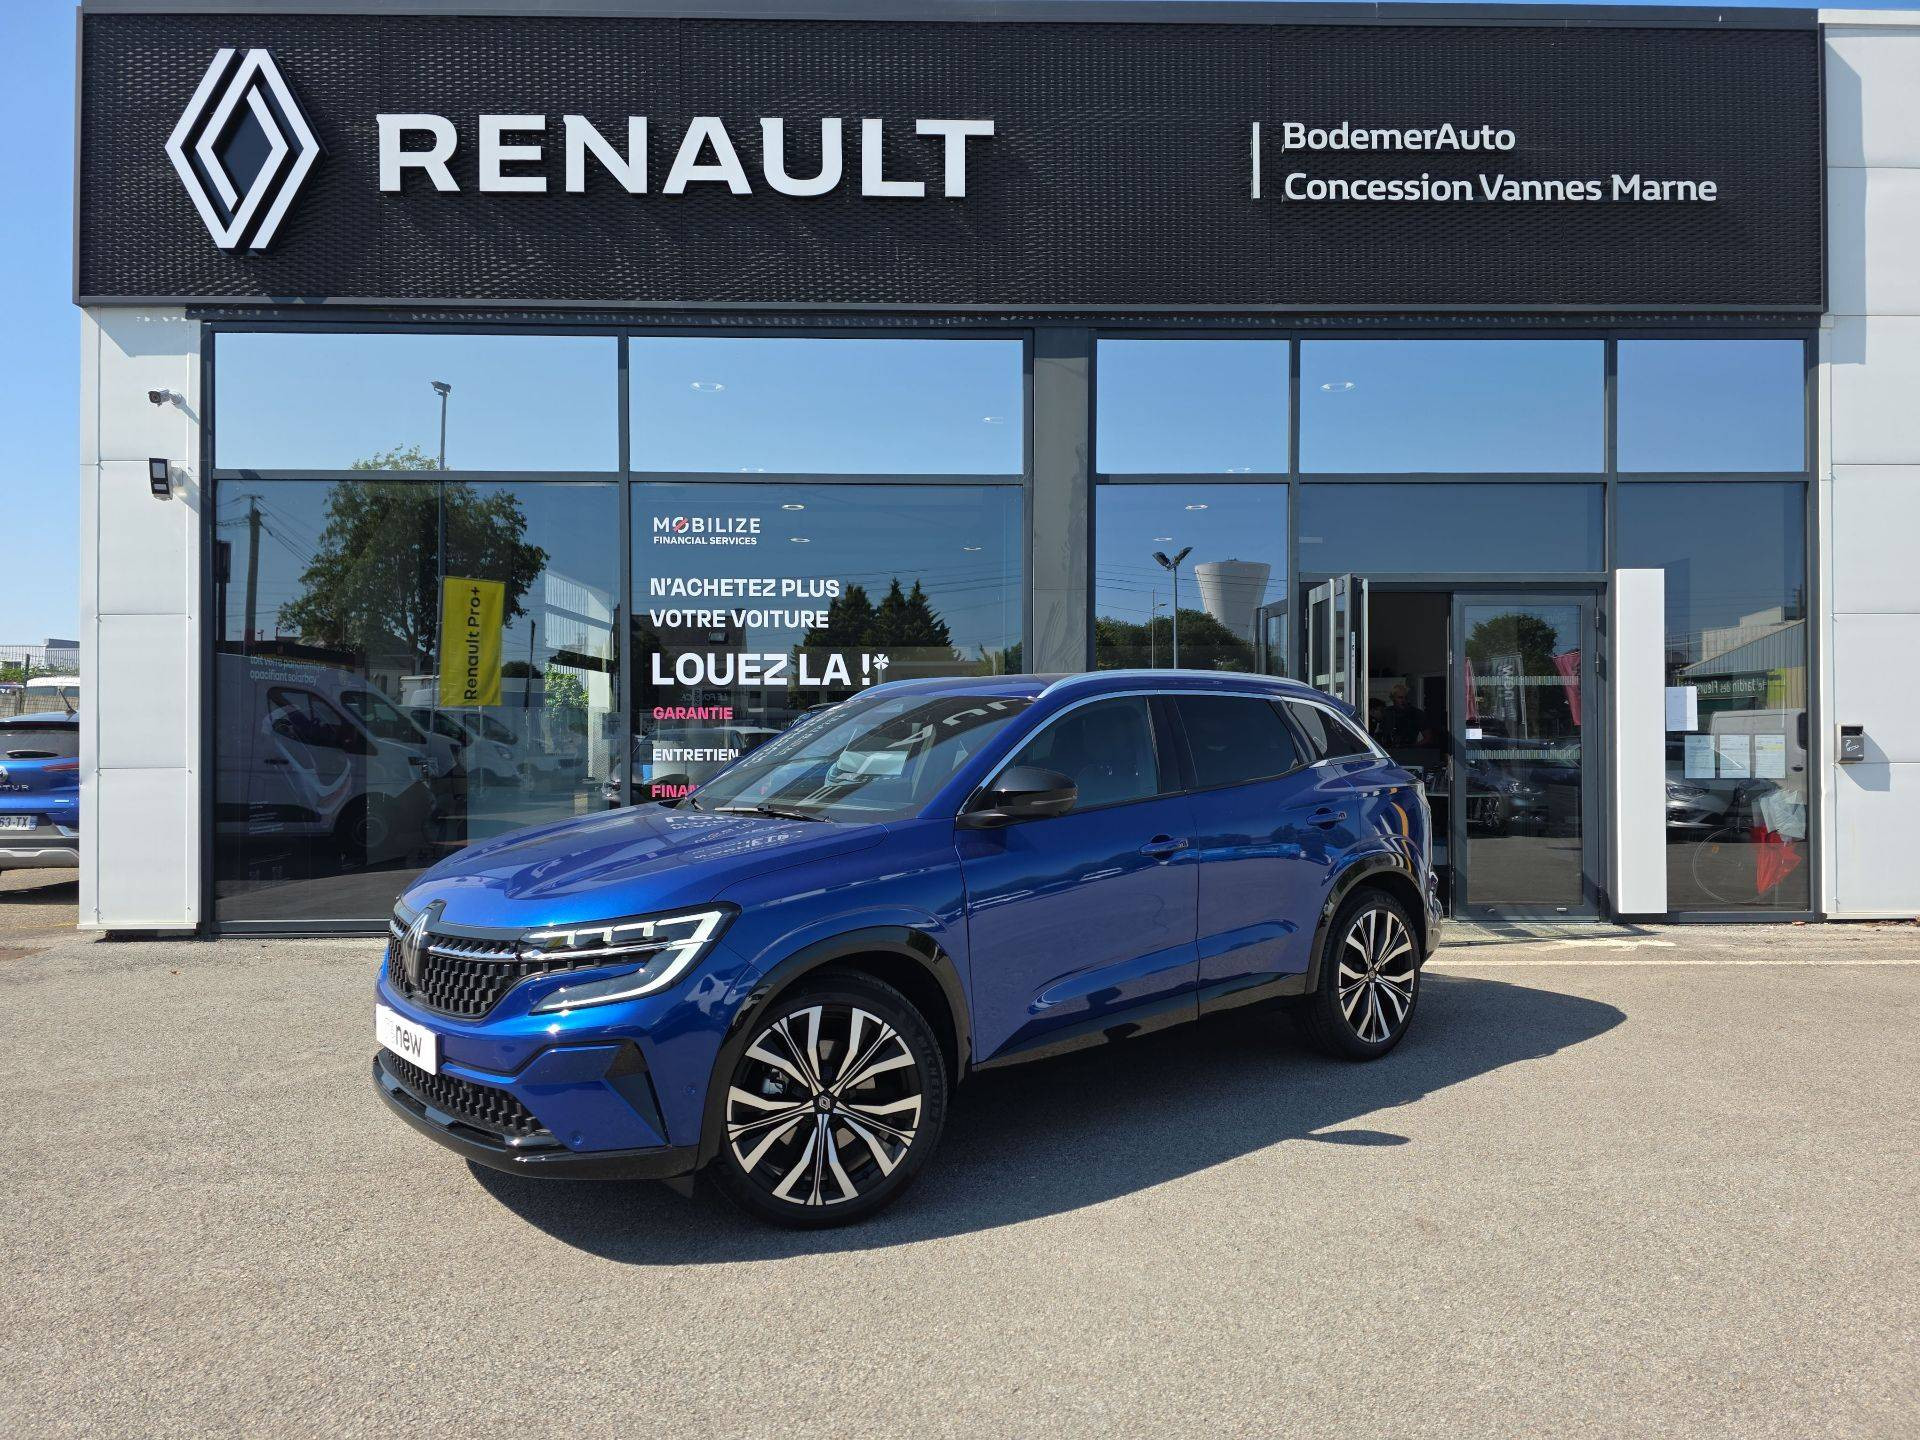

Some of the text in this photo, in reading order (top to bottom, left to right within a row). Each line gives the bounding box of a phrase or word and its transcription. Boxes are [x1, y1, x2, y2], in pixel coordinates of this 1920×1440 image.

[1283, 121, 1516, 150] BodemerAuto
[375, 113, 995, 198] RENAULT
[1284, 172, 1718, 201] Concession Vannes Marne
[653, 516, 761, 533] MOBILIZE
[653, 536, 757, 545] FINANCIAL SERVICES
[650, 577, 840, 598] N'ACHETEZ PLUS
[650, 609, 829, 629] VOTRE VOITURE
[464, 586, 481, 700] Renault Pro+
[250, 668, 317, 686] opacifiant solarbay
[652, 652, 788, 686] LOUEZ
[799, 653, 852, 686] LA
[653, 706, 733, 719] GARANTIE
[652, 748, 739, 761] ENTRETIEN
